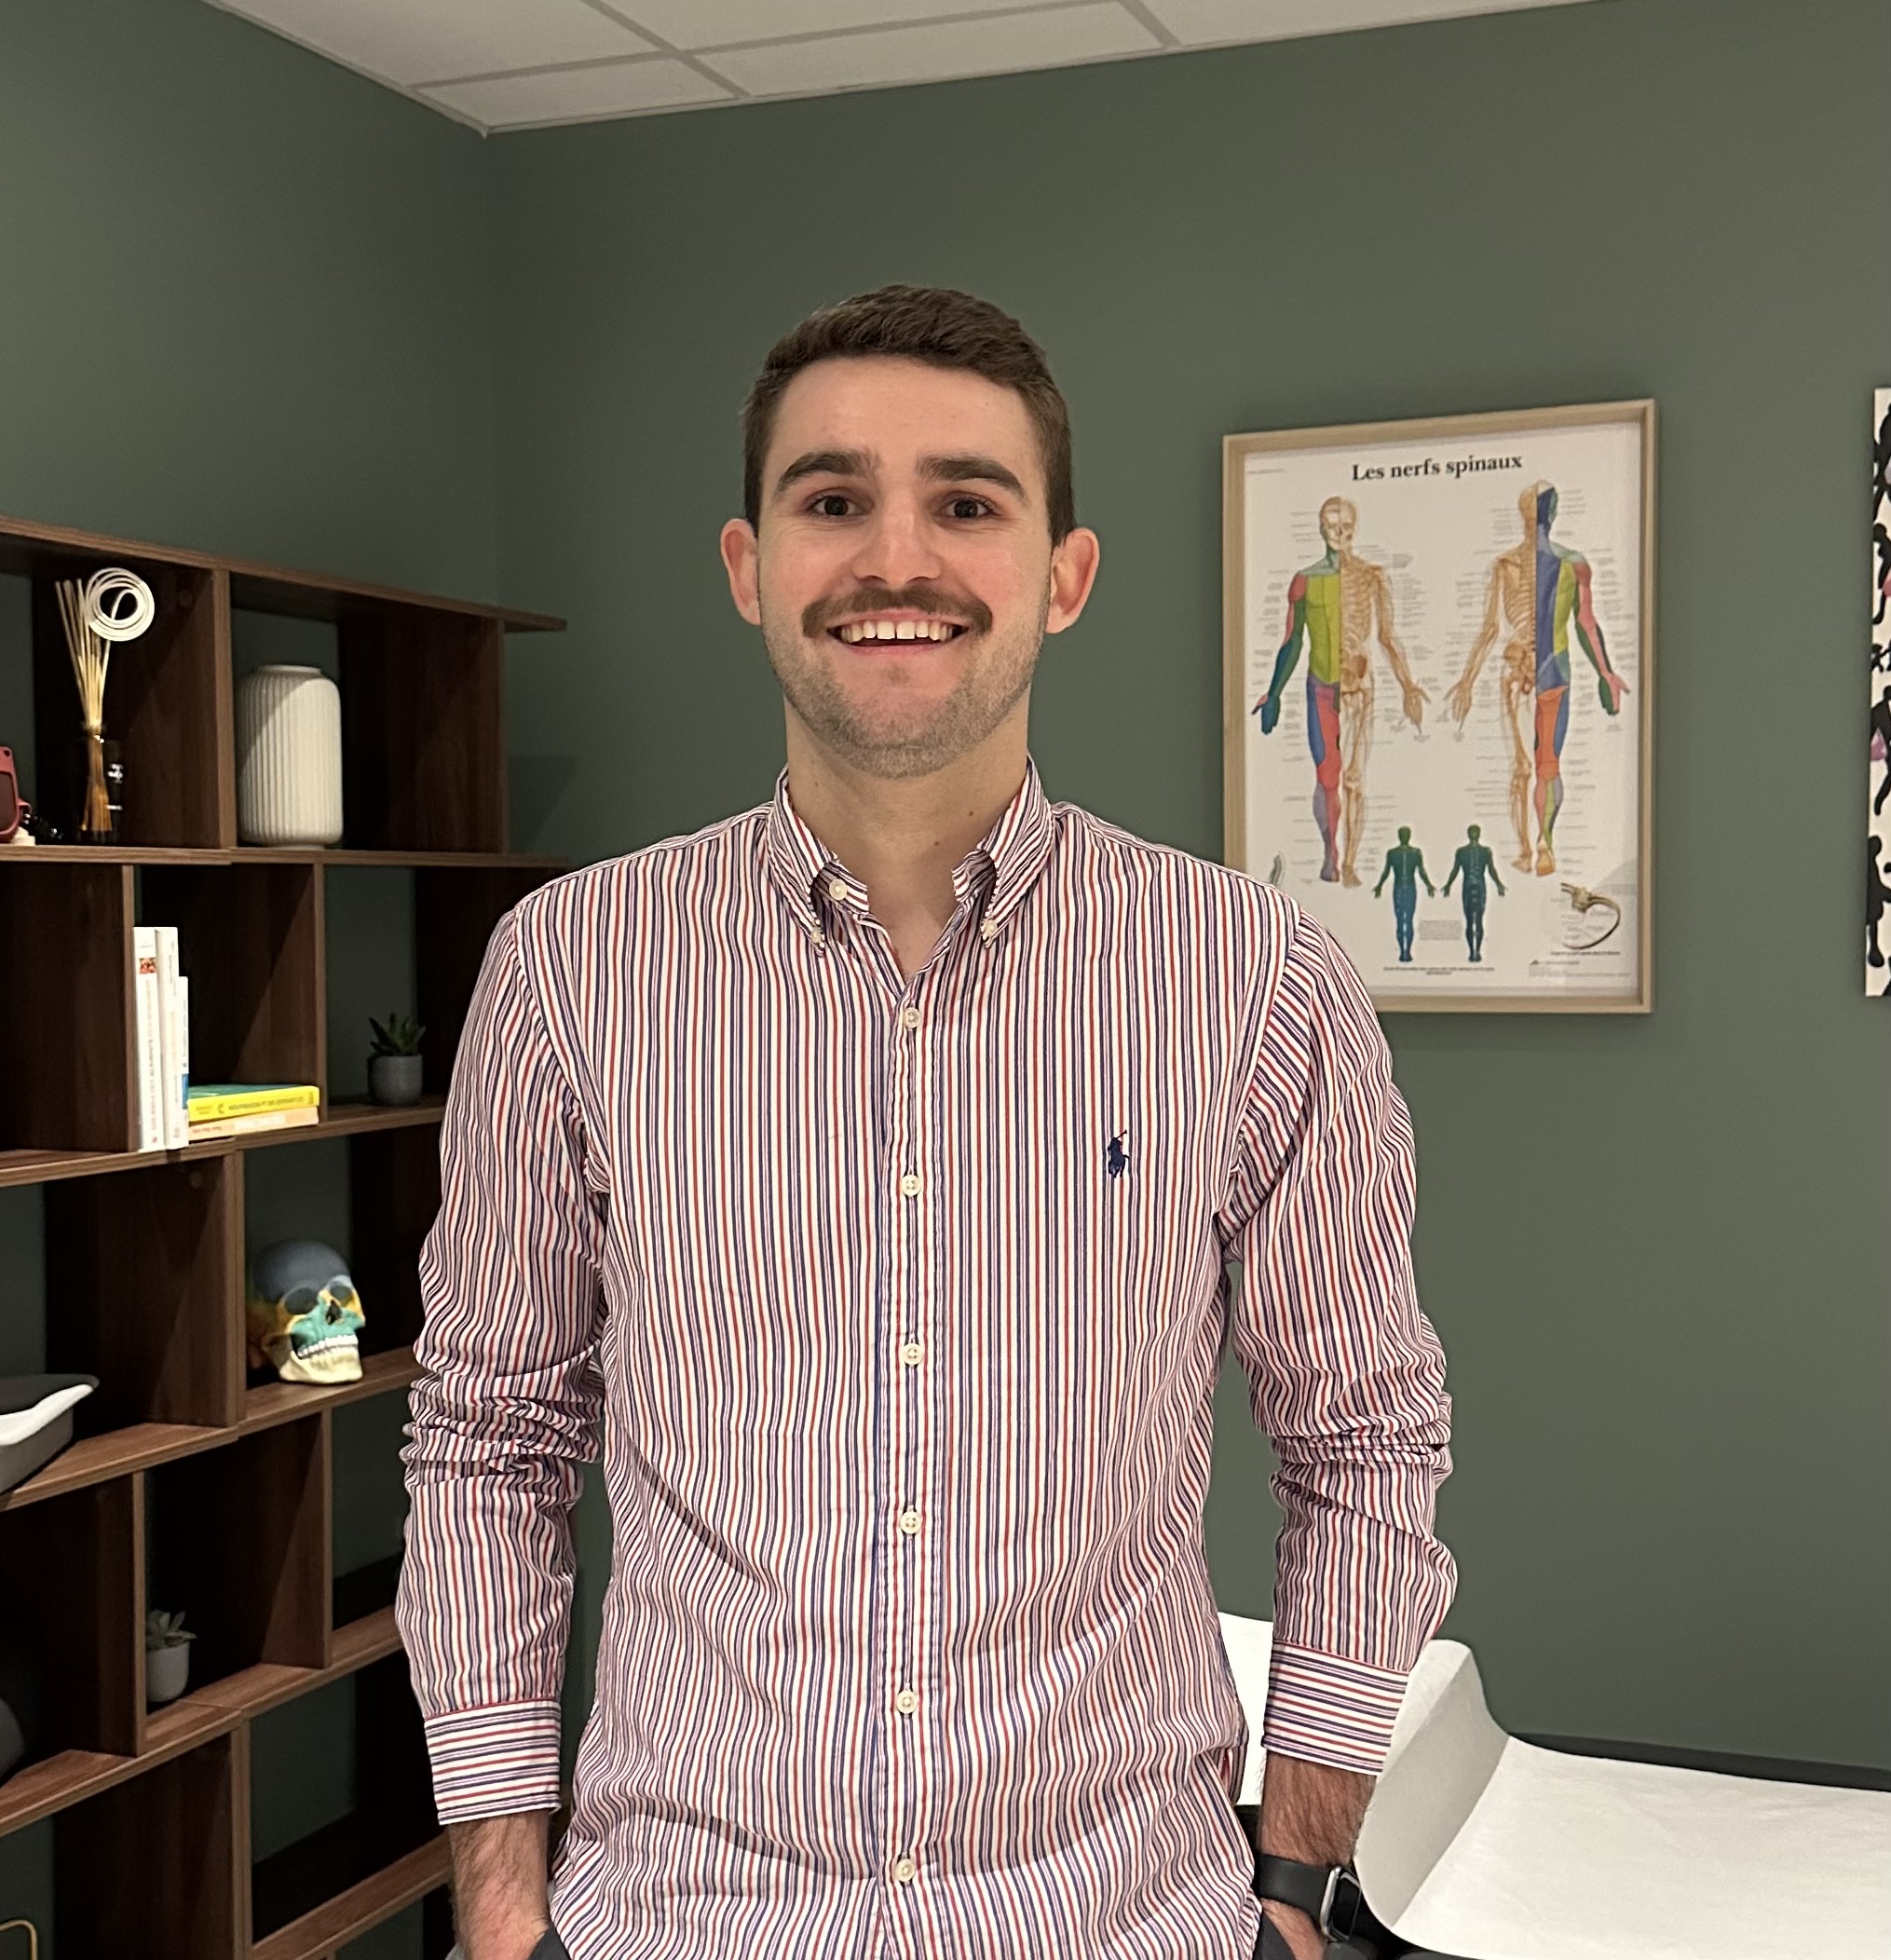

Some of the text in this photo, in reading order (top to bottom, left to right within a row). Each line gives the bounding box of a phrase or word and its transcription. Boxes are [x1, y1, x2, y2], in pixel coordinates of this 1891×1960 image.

[1352, 455, 1523, 481] Les nerfs spinaux
